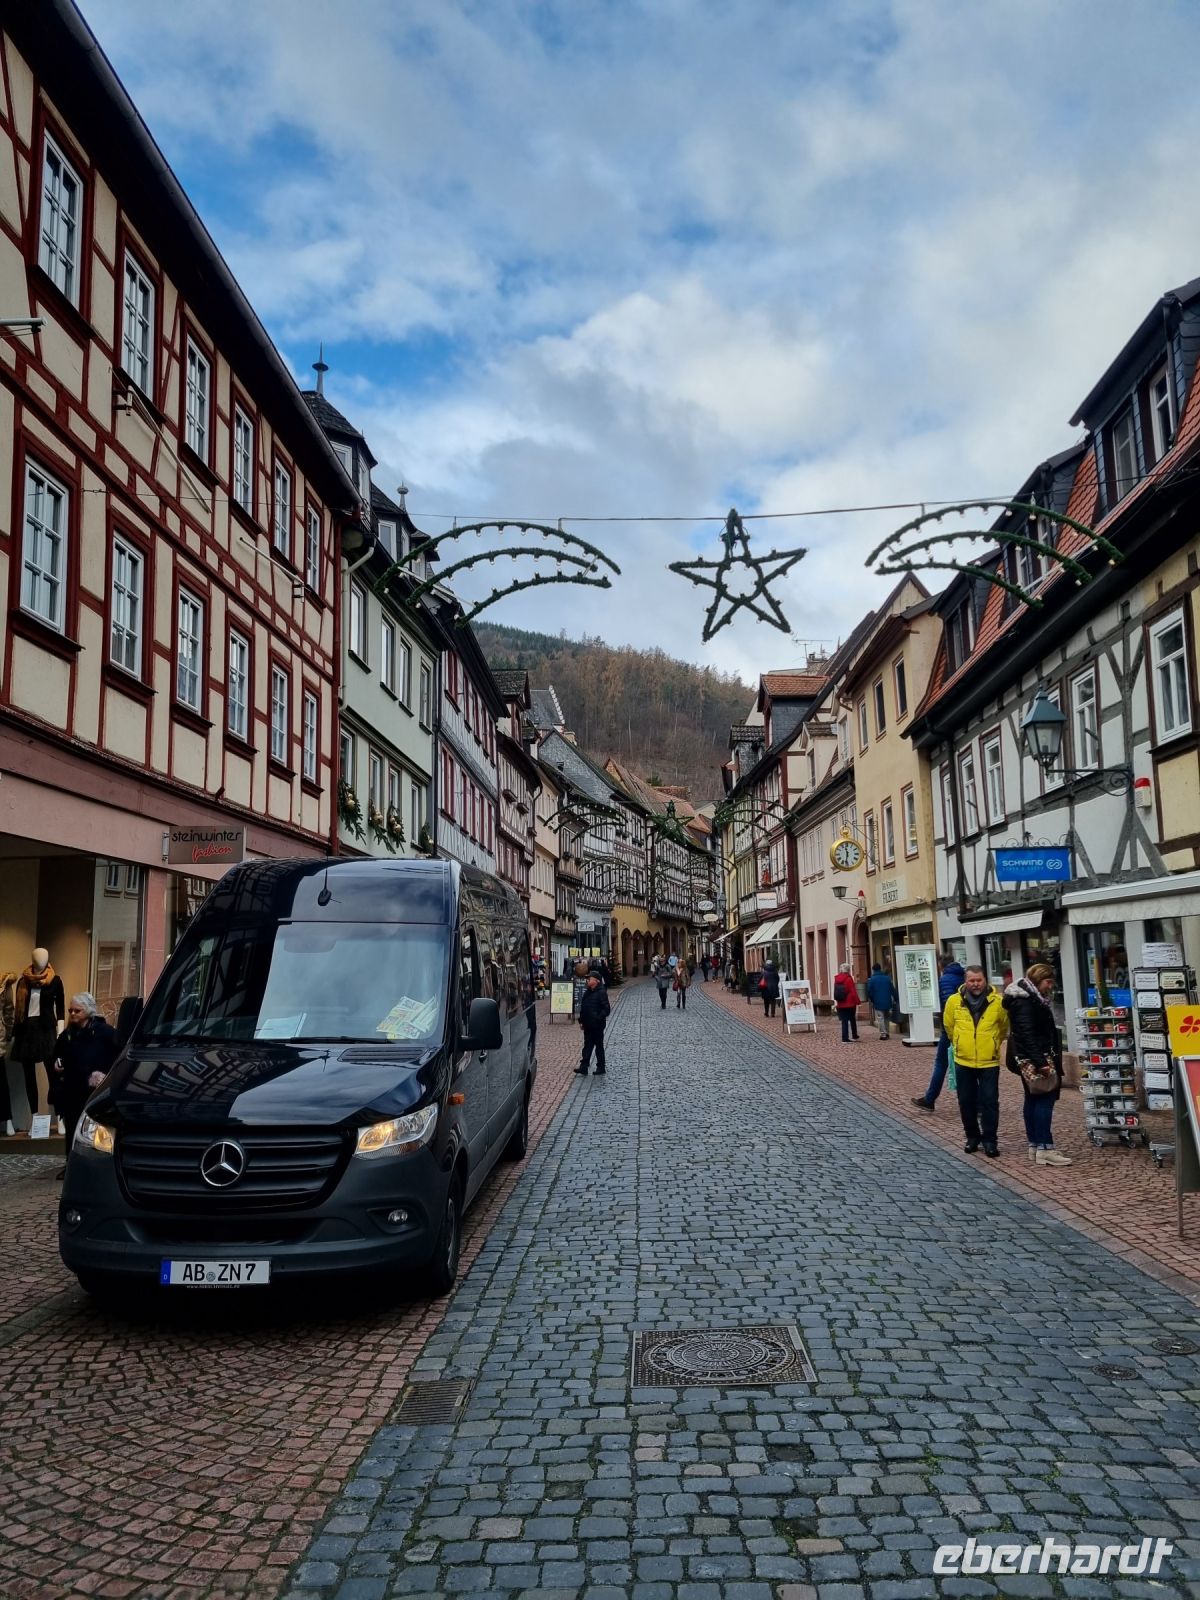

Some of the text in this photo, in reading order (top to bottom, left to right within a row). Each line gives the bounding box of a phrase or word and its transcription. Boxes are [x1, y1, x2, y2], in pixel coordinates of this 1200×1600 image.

[172, 829, 241, 842] steinwinter
[192, 842, 232, 862] fashion
[183, 1263, 256, 1281] AB ZN 7
